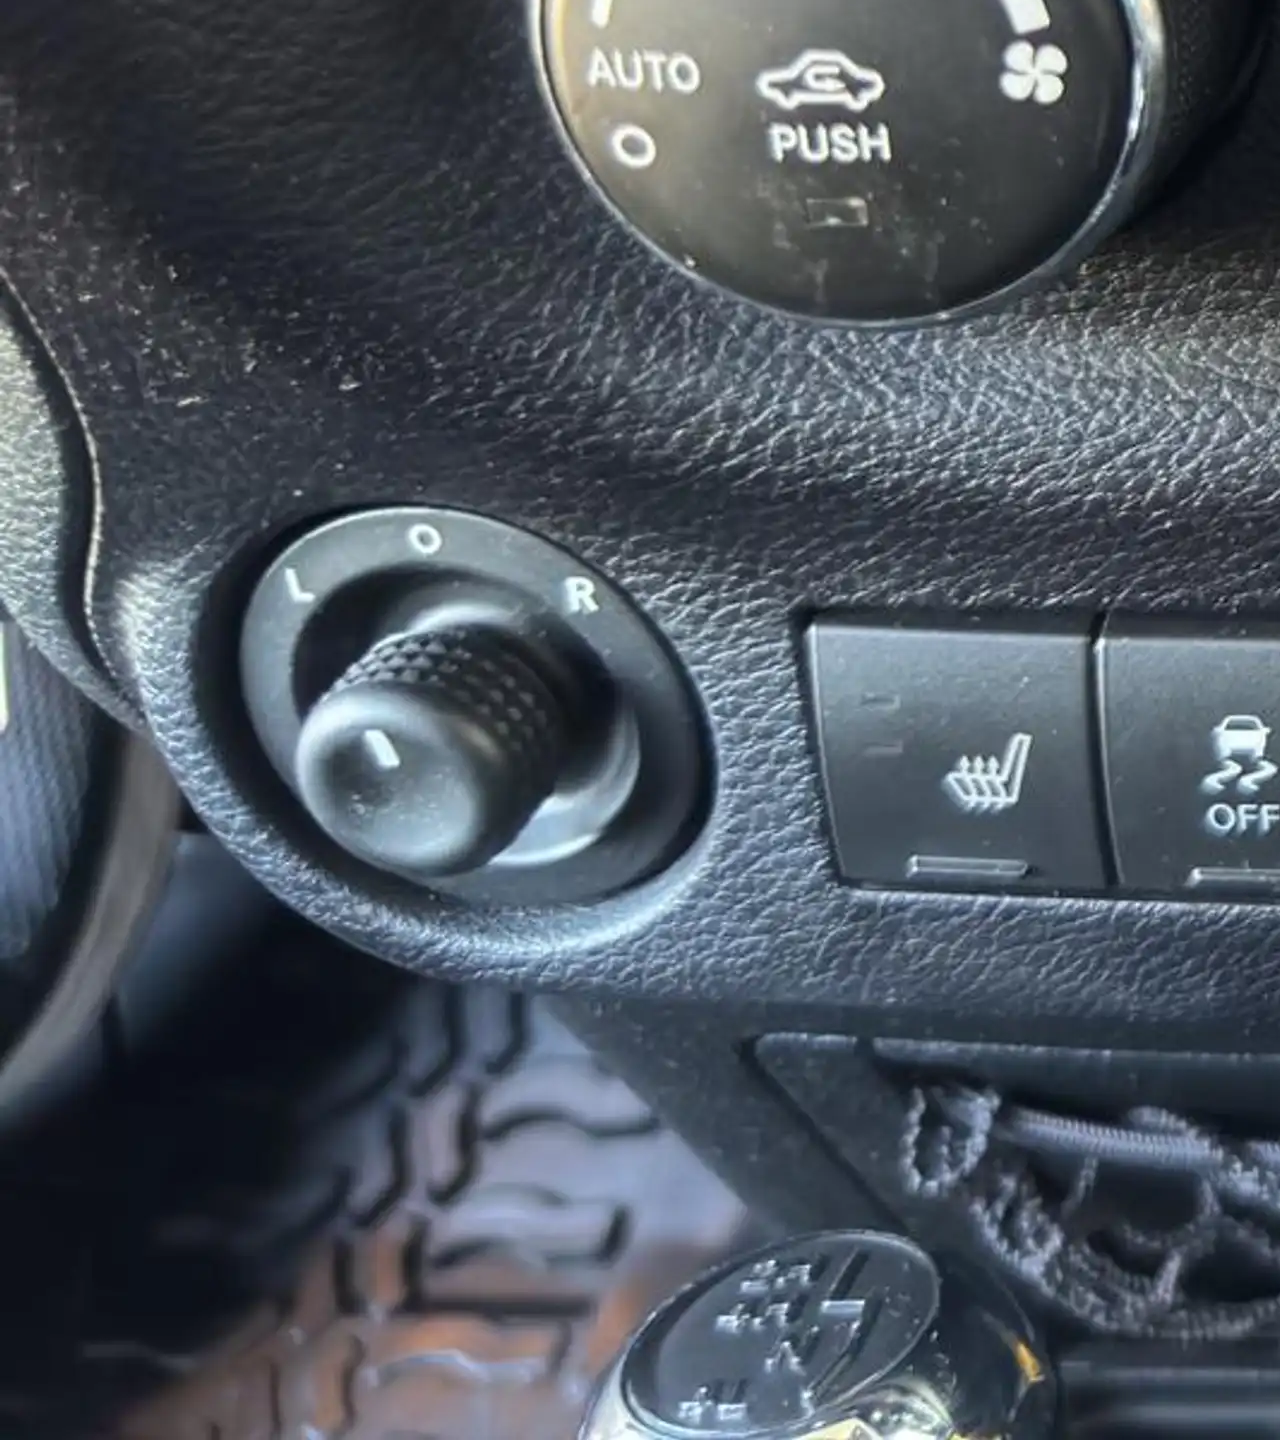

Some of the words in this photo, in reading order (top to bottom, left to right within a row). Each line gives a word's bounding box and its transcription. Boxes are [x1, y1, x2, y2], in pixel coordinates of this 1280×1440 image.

[586, 48, 701, 93] AUTO
[768, 122, 892, 163] PUSH
[284, 567, 316, 604] L
[564, 576, 600, 614] R
